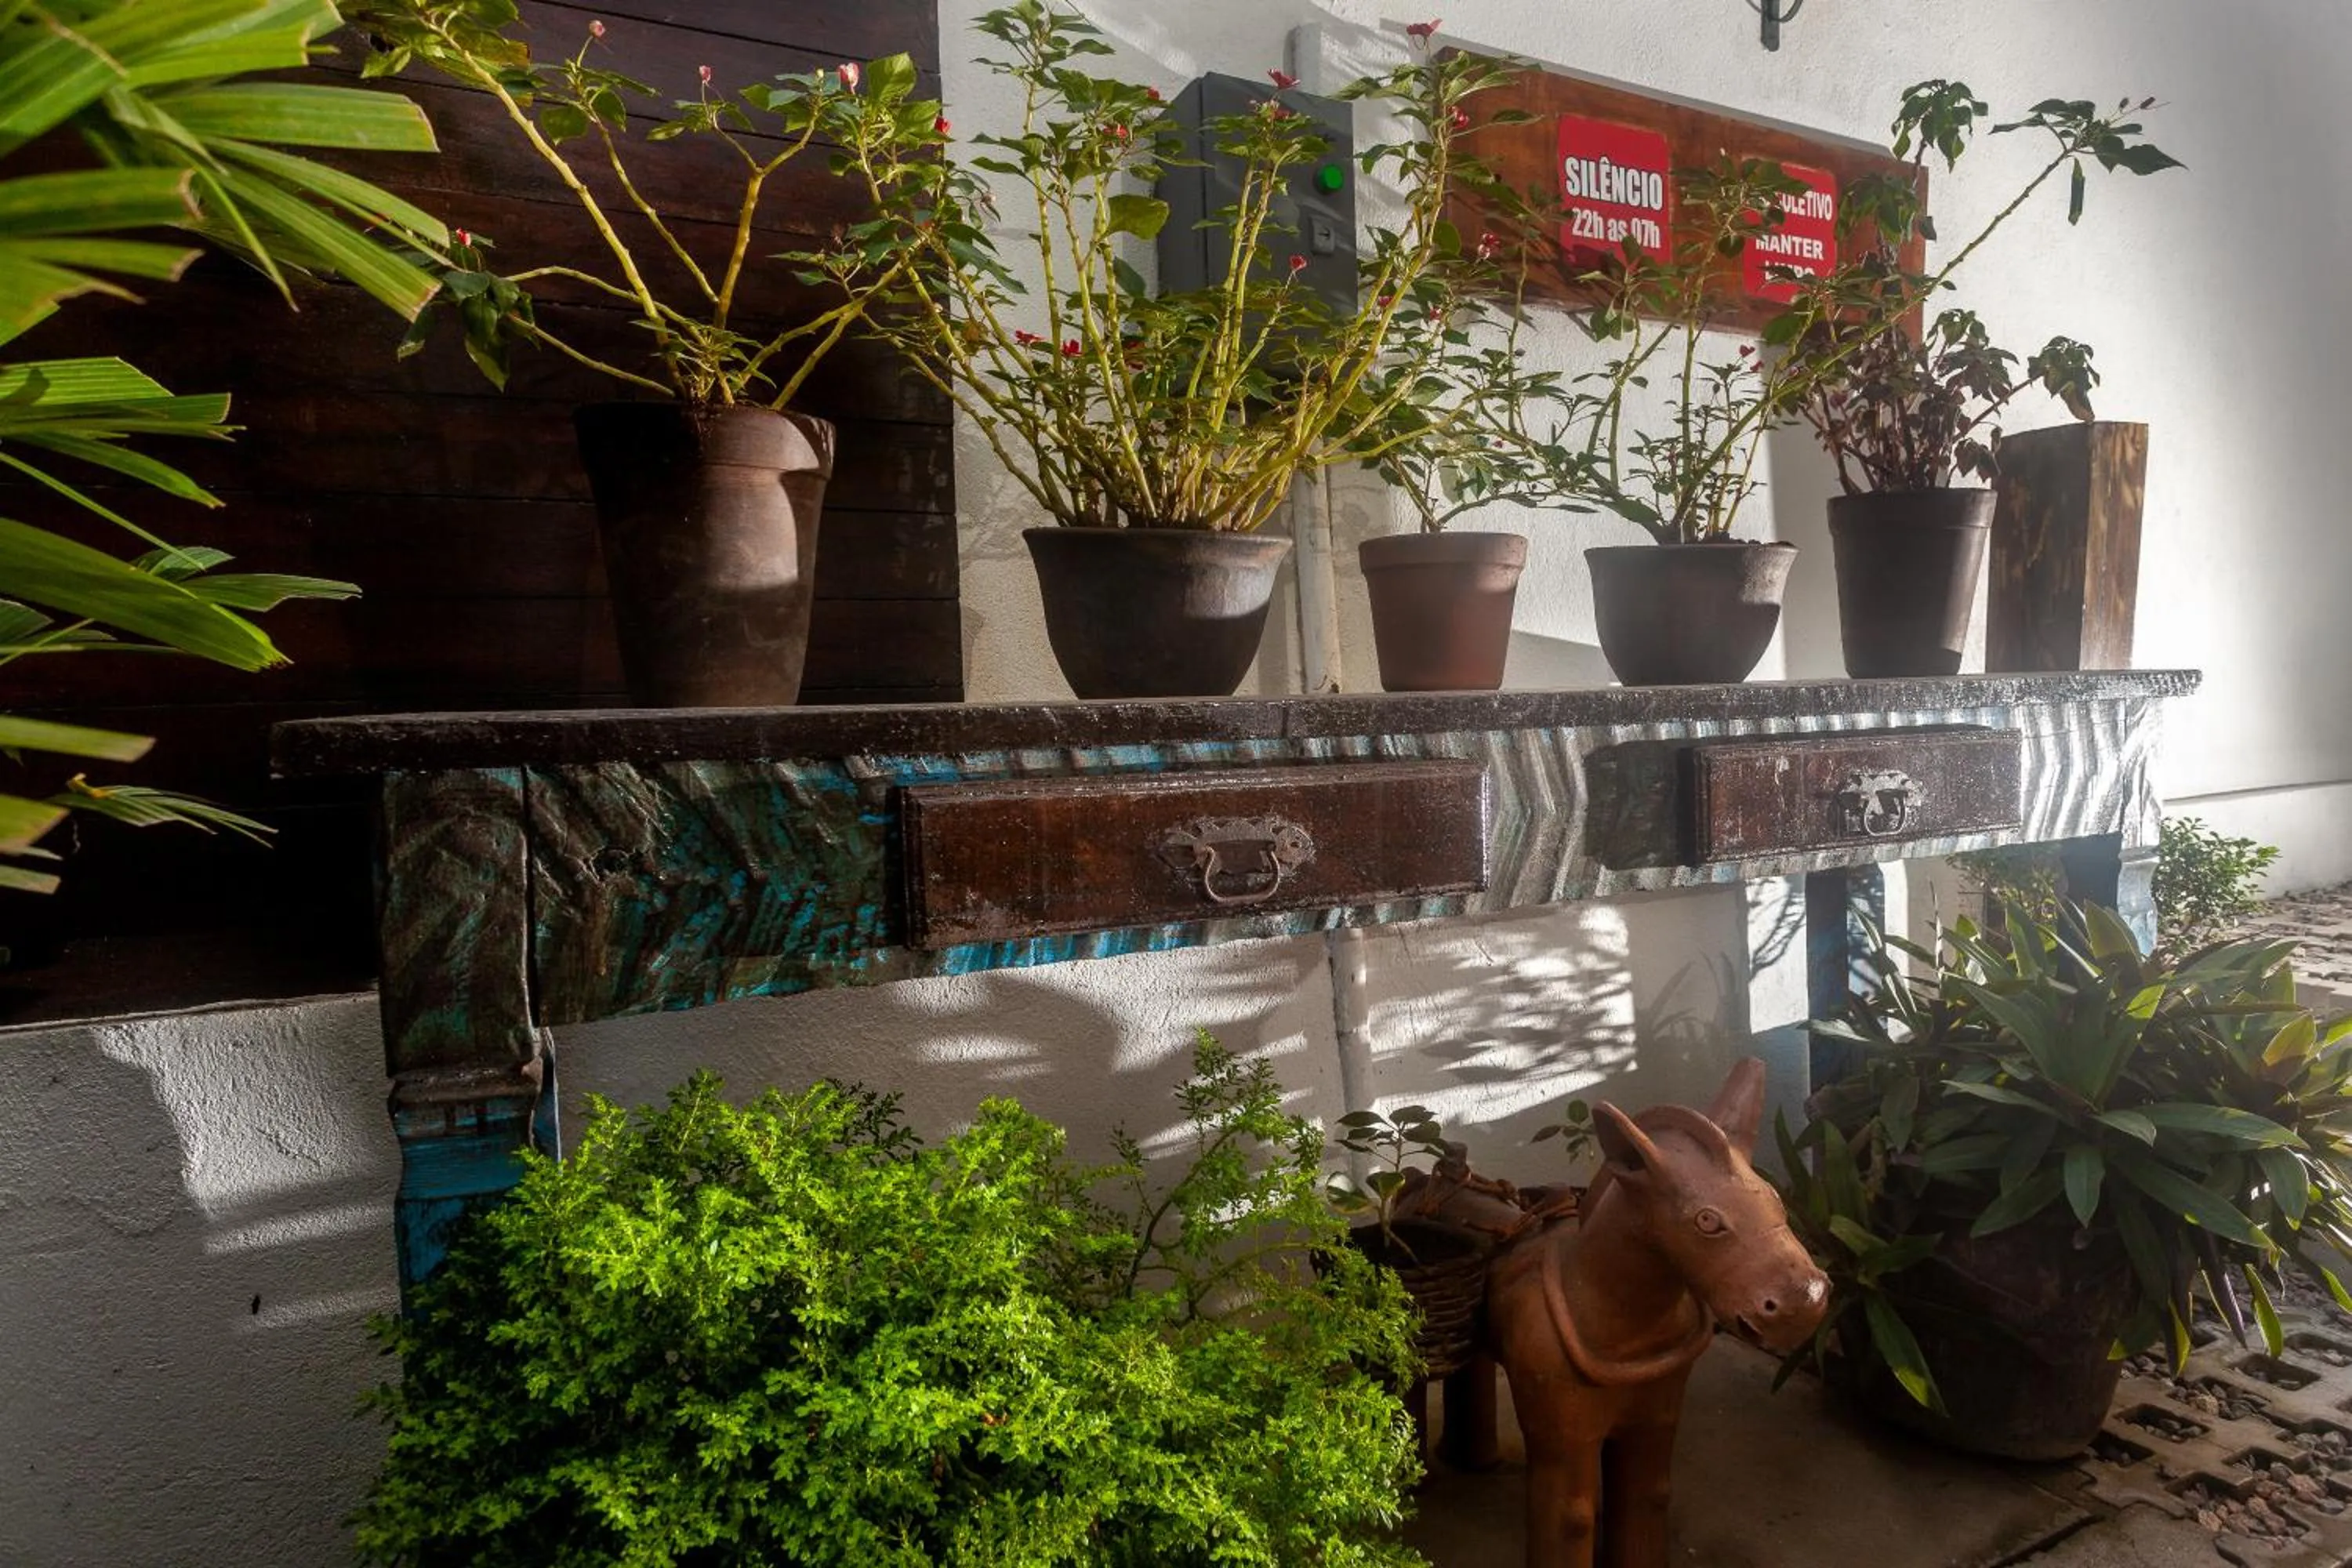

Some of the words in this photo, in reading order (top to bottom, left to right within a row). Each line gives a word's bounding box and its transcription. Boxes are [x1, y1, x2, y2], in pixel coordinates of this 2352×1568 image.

[1565, 155, 1663, 211] SILÊNCIO
[1774, 190, 1833, 221] OLETIVO
[1572, 206, 1604, 239] 22h
[1606, 218, 1628, 242] as
[1632, 217, 1661, 249] 07h
[1755, 234, 1824, 261] MANTER
